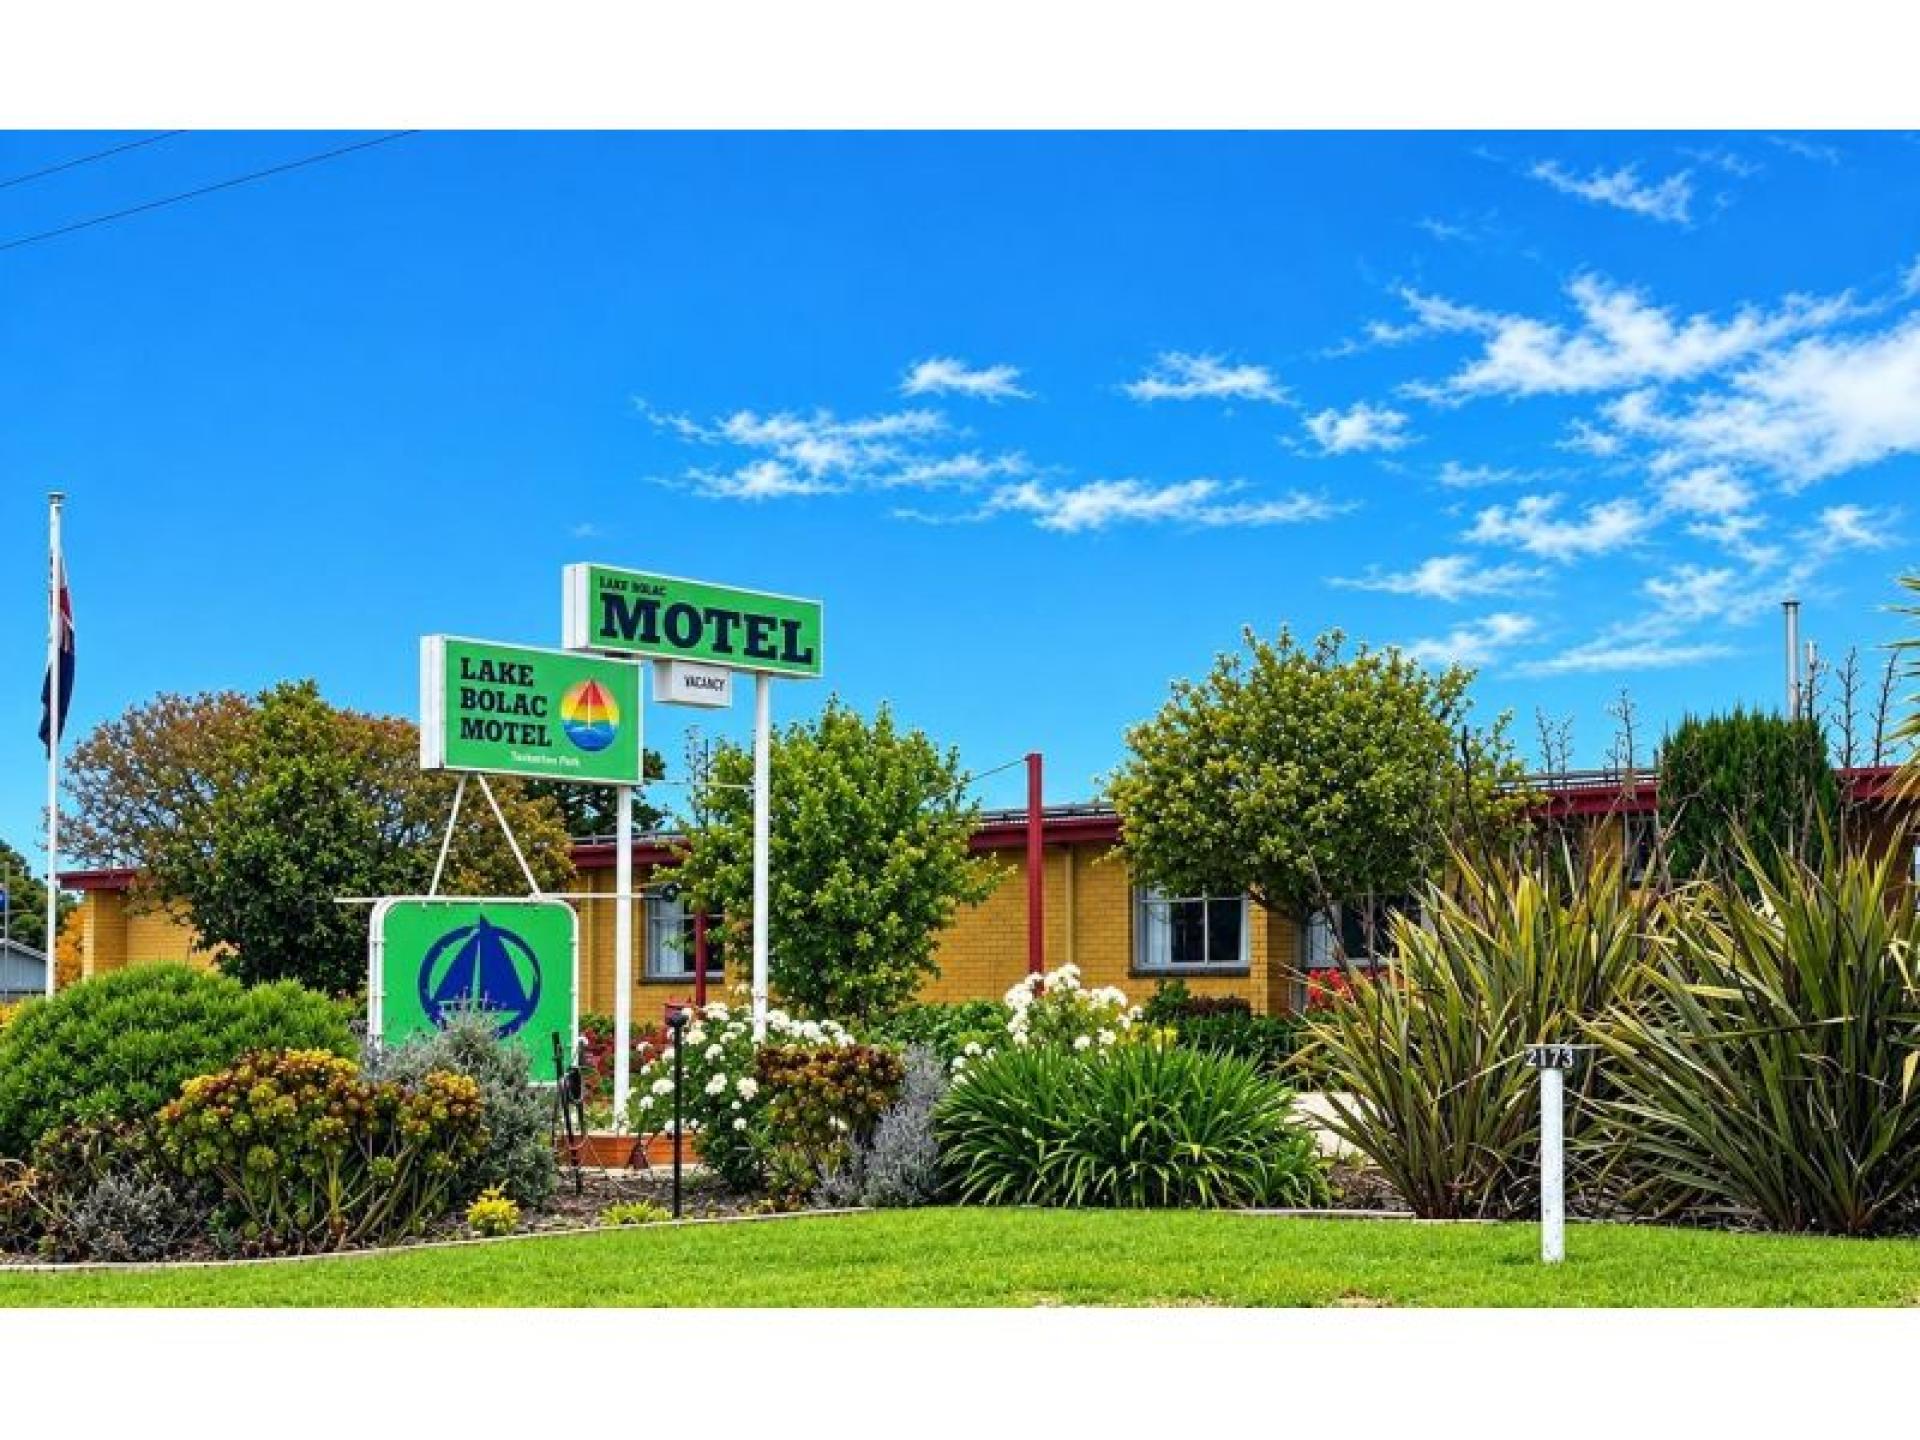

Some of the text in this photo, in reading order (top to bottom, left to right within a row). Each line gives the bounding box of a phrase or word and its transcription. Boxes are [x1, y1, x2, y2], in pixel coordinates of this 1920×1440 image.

[599, 576, 667, 596] LAKE BOLAC
[600, 592, 813, 664] MOTEL
[461, 657, 534, 686] LAKE
[683, 674, 725, 692] VACANCY
[461, 686, 548, 717] BOLAC
[461, 717, 552, 747] MOTEL
[1524, 1047, 1573, 1069] 2173
